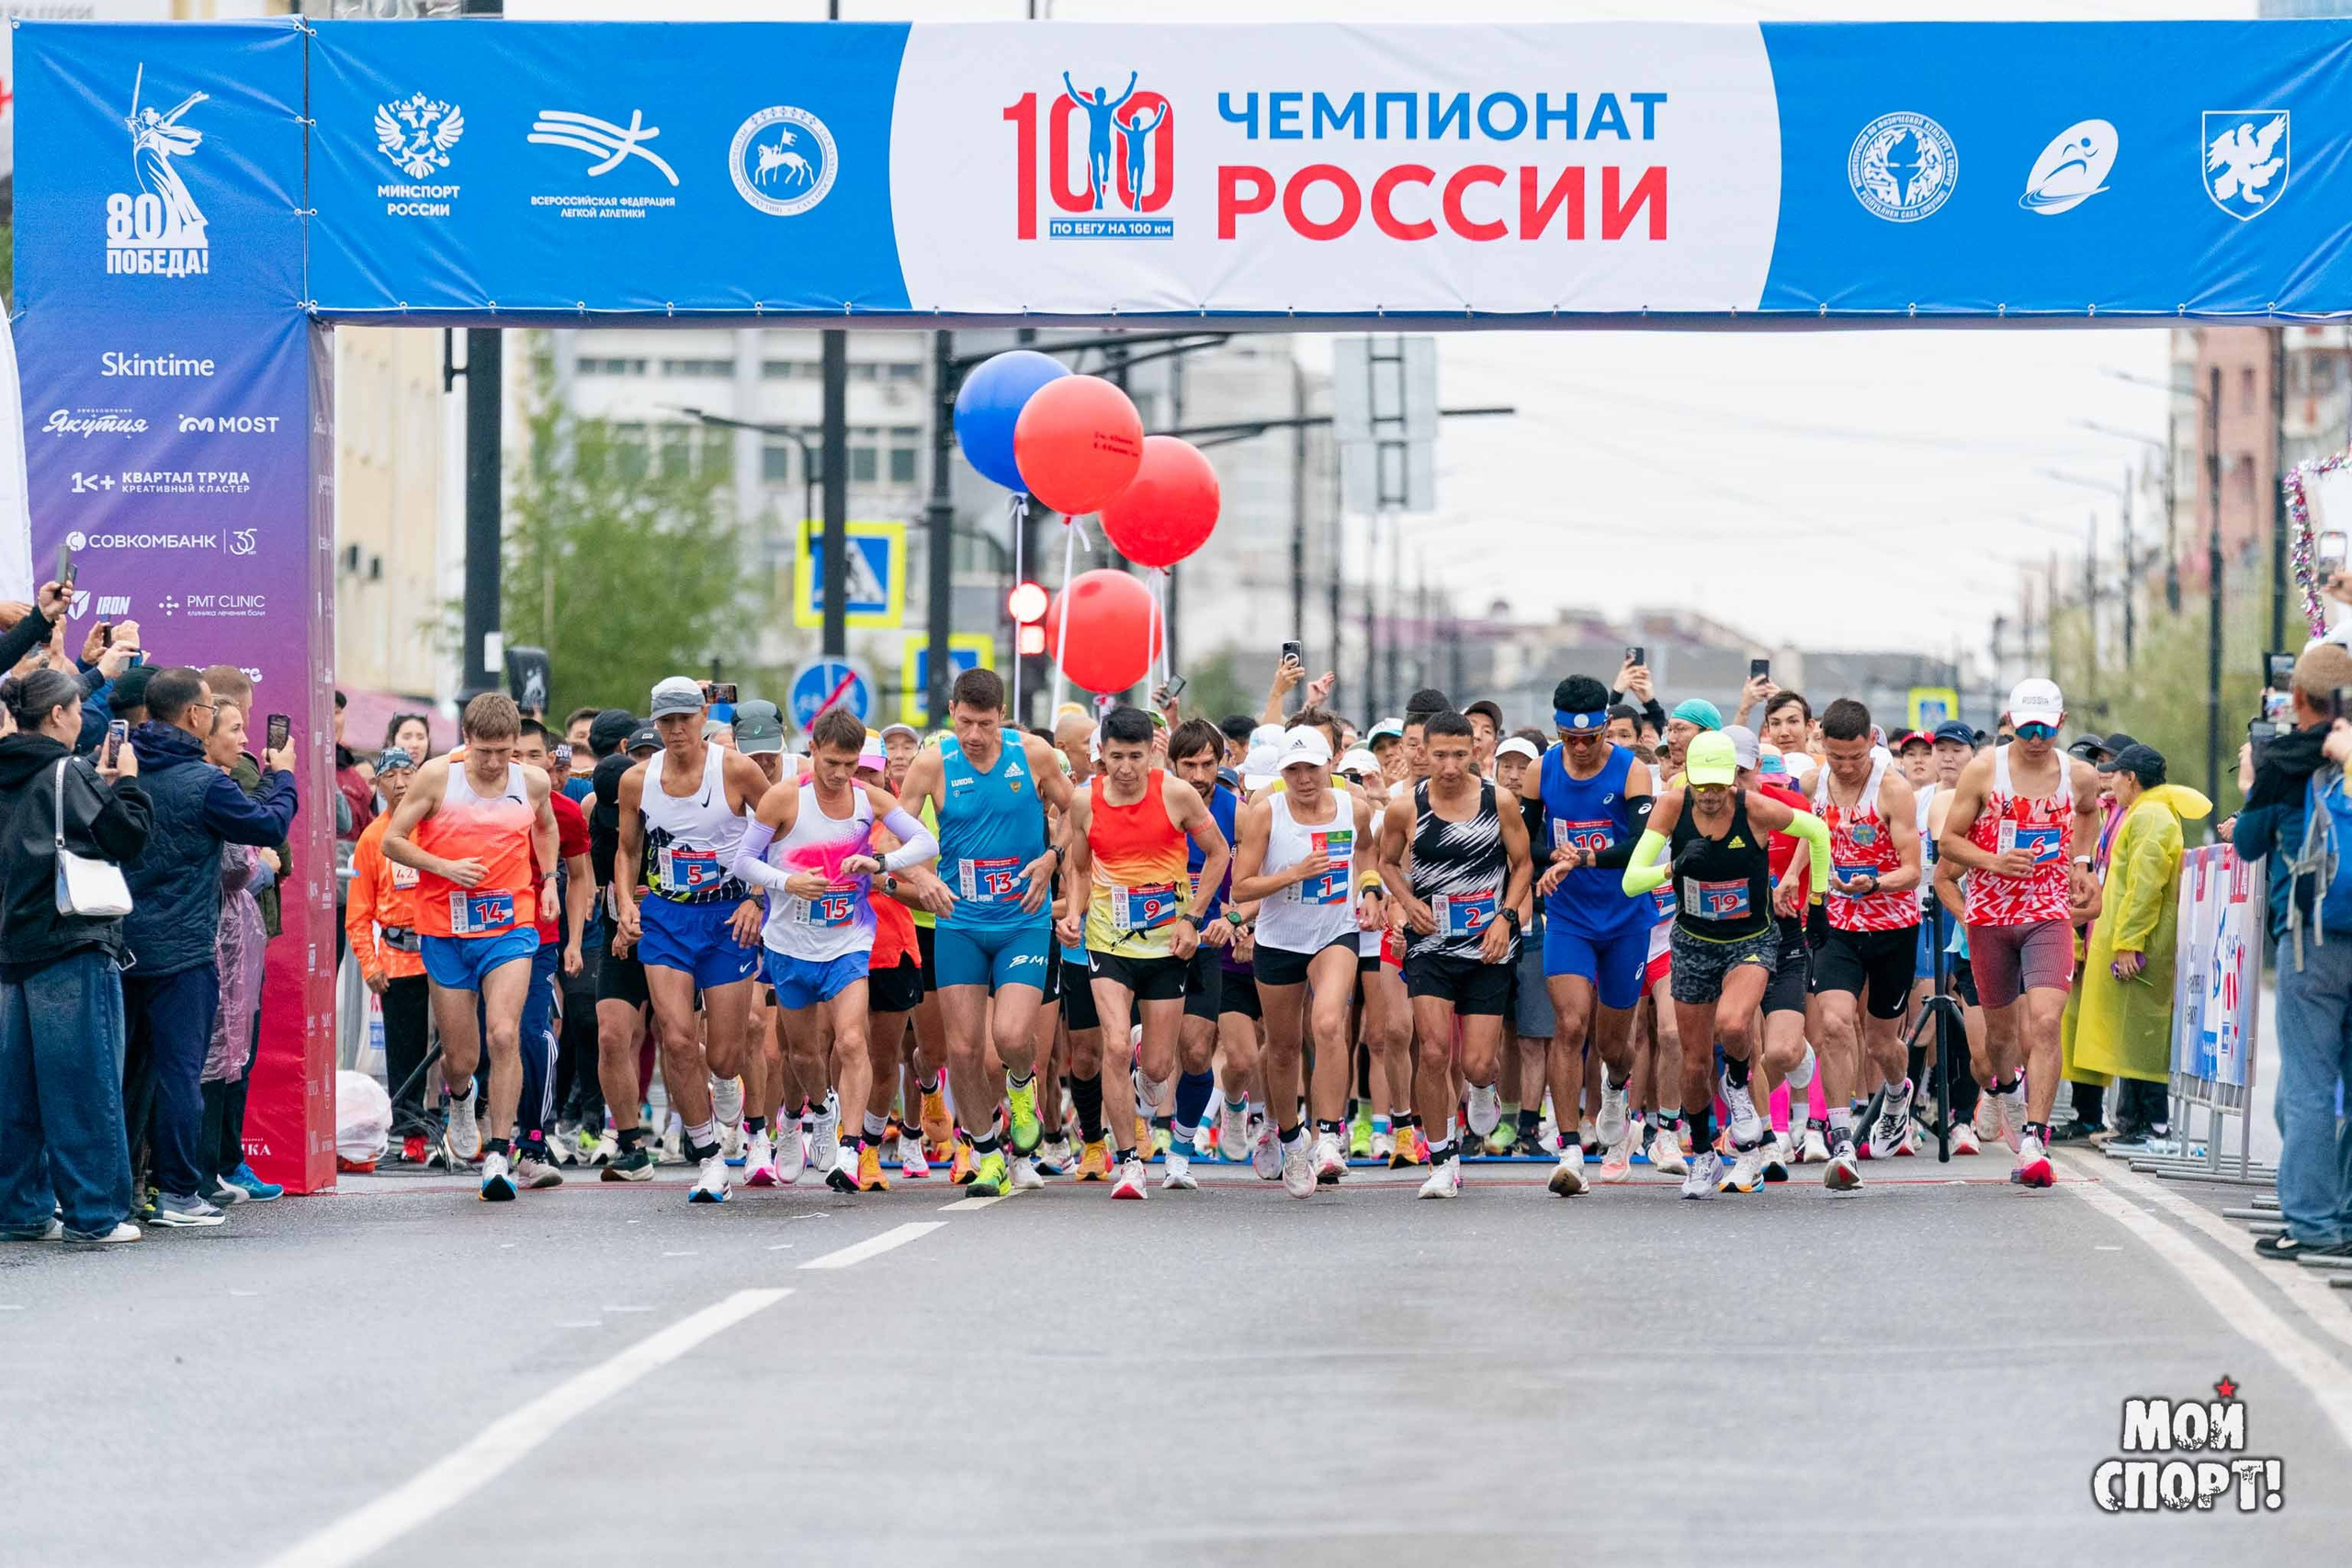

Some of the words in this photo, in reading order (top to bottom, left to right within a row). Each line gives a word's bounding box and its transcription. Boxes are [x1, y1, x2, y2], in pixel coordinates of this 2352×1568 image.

[1217, 92, 1668, 141] ЧЕМПИОНАТ
[1002, 92, 1174, 241] 100
[378, 185, 460, 198] МИНСПОРТ
[530, 196, 617, 207] ВСЕРОССИЙСКАЯ
[619, 196, 675, 208] ФЕДЕРАЦИЯ
[387, 202, 450, 217] РОССИИ
[560, 208, 596, 219] ЛЕГКОЙ
[599, 208, 646, 219] АТЛЕТИКИ
[1217, 164, 1668, 242] РОССИИ
[107, 193, 164, 241] 80
[1052, 222, 1072, 234] ПО
[1075, 222, 1105, 234] БЕГУ
[1108, 223, 1126, 234] НА
[1129, 223, 1152, 234] 100
[1154, 226, 1170, 234] км
[106, 249, 209, 278] ПОБЕДА!
[101, 352, 215, 377] Skintime
[42, 410, 149, 439] Якутия
[219, 416, 279, 433] MOST
[121, 484, 195, 494] КРЕАТИВНЫЙ
[198, 485, 250, 494] КЛАСТЕР
[122, 471, 193, 484] КВАРТАЛ
[197, 471, 250, 485] ТРУДА
[88, 535, 218, 548] СОВКОМБАНК
[230, 528, 258, 556] 35
[96, 596, 131, 615] IRON
[187, 595, 216, 607] PMT
[218, 595, 266, 608] CLINIC
[1574, 832, 1608, 852] 10
[2029, 835, 2046, 857] 6
[396, 868, 414, 879] 42
[687, 864, 704, 886] 5
[983, 872, 1013, 895] 13
[1320, 874, 1333, 897] 1
[476, 901, 505, 923] 14
[820, 897, 849, 919] 15
[1144, 898, 1161, 920] 9
[1708, 893, 1740, 913] 19
[1464, 907, 1482, 929] 2
